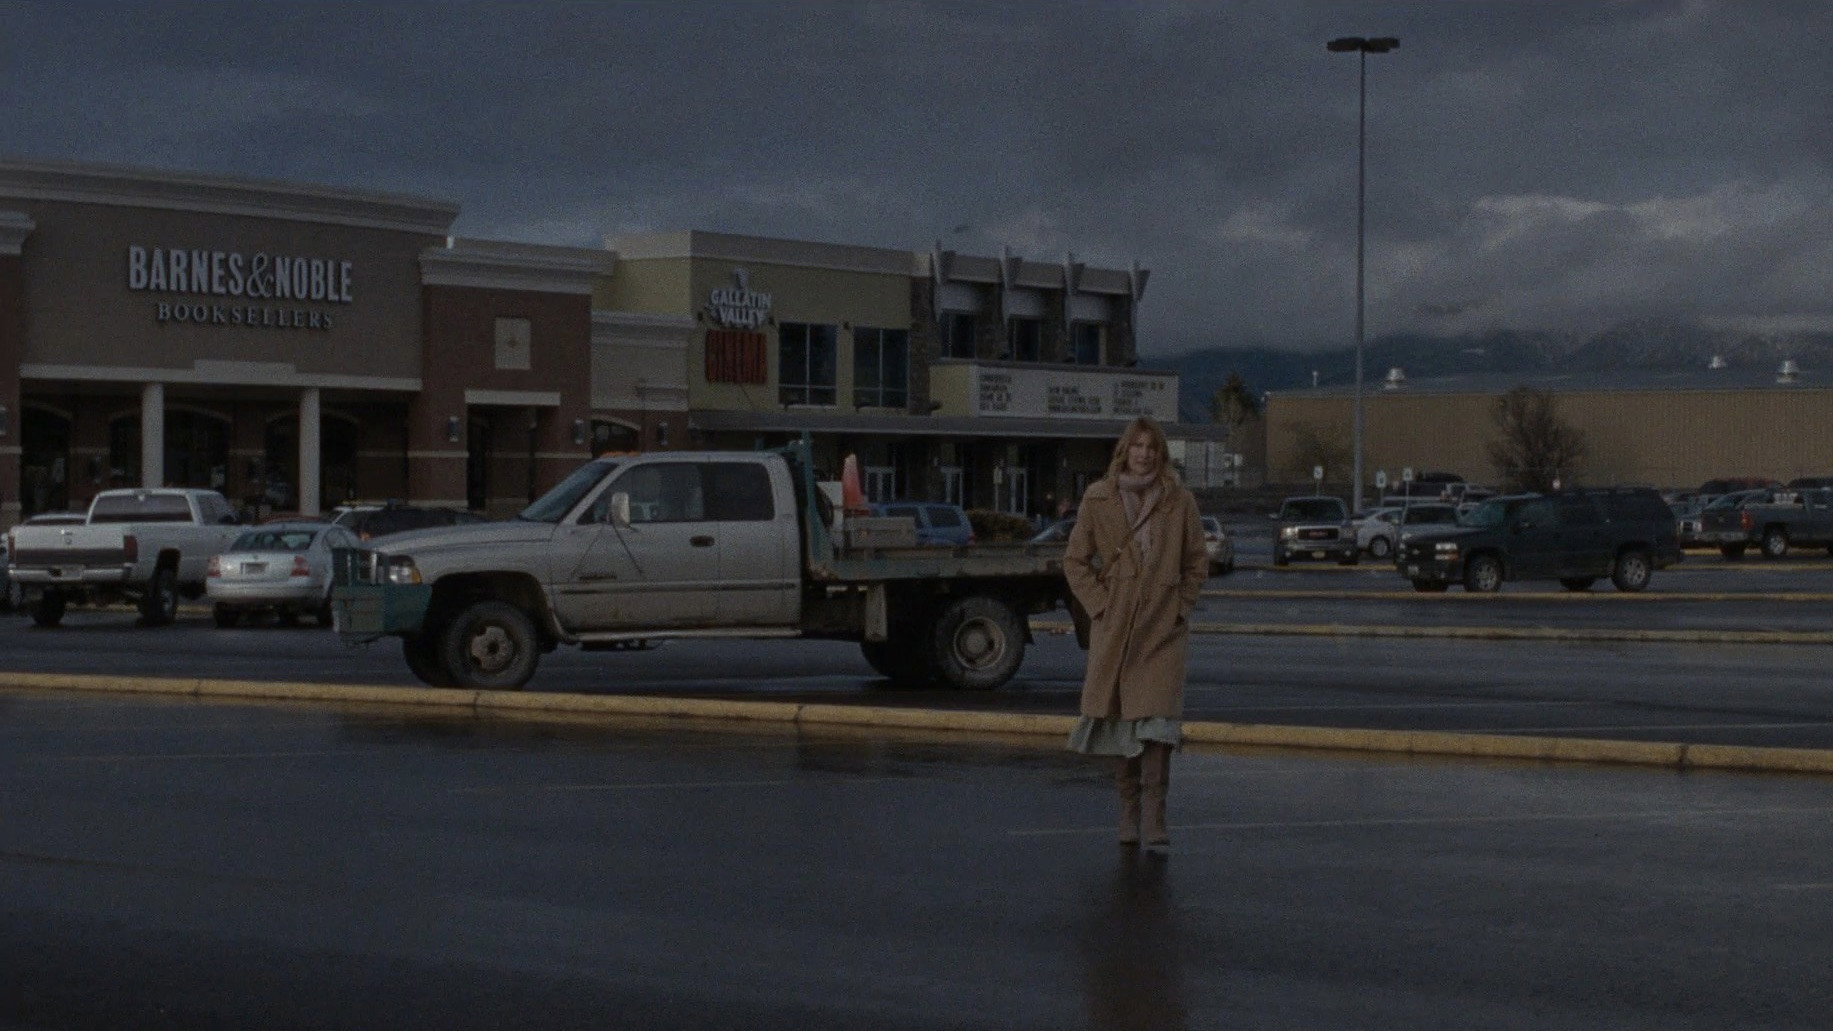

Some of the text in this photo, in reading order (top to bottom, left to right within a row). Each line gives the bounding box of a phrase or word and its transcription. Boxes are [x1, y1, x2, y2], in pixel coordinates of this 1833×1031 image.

[128, 245, 353, 302] BARNES & NOBLE
[711, 288, 771, 307] GALLATIN
[157, 302, 334, 329] BOOKSELLERS
[719, 306, 765, 329] VALLEY
